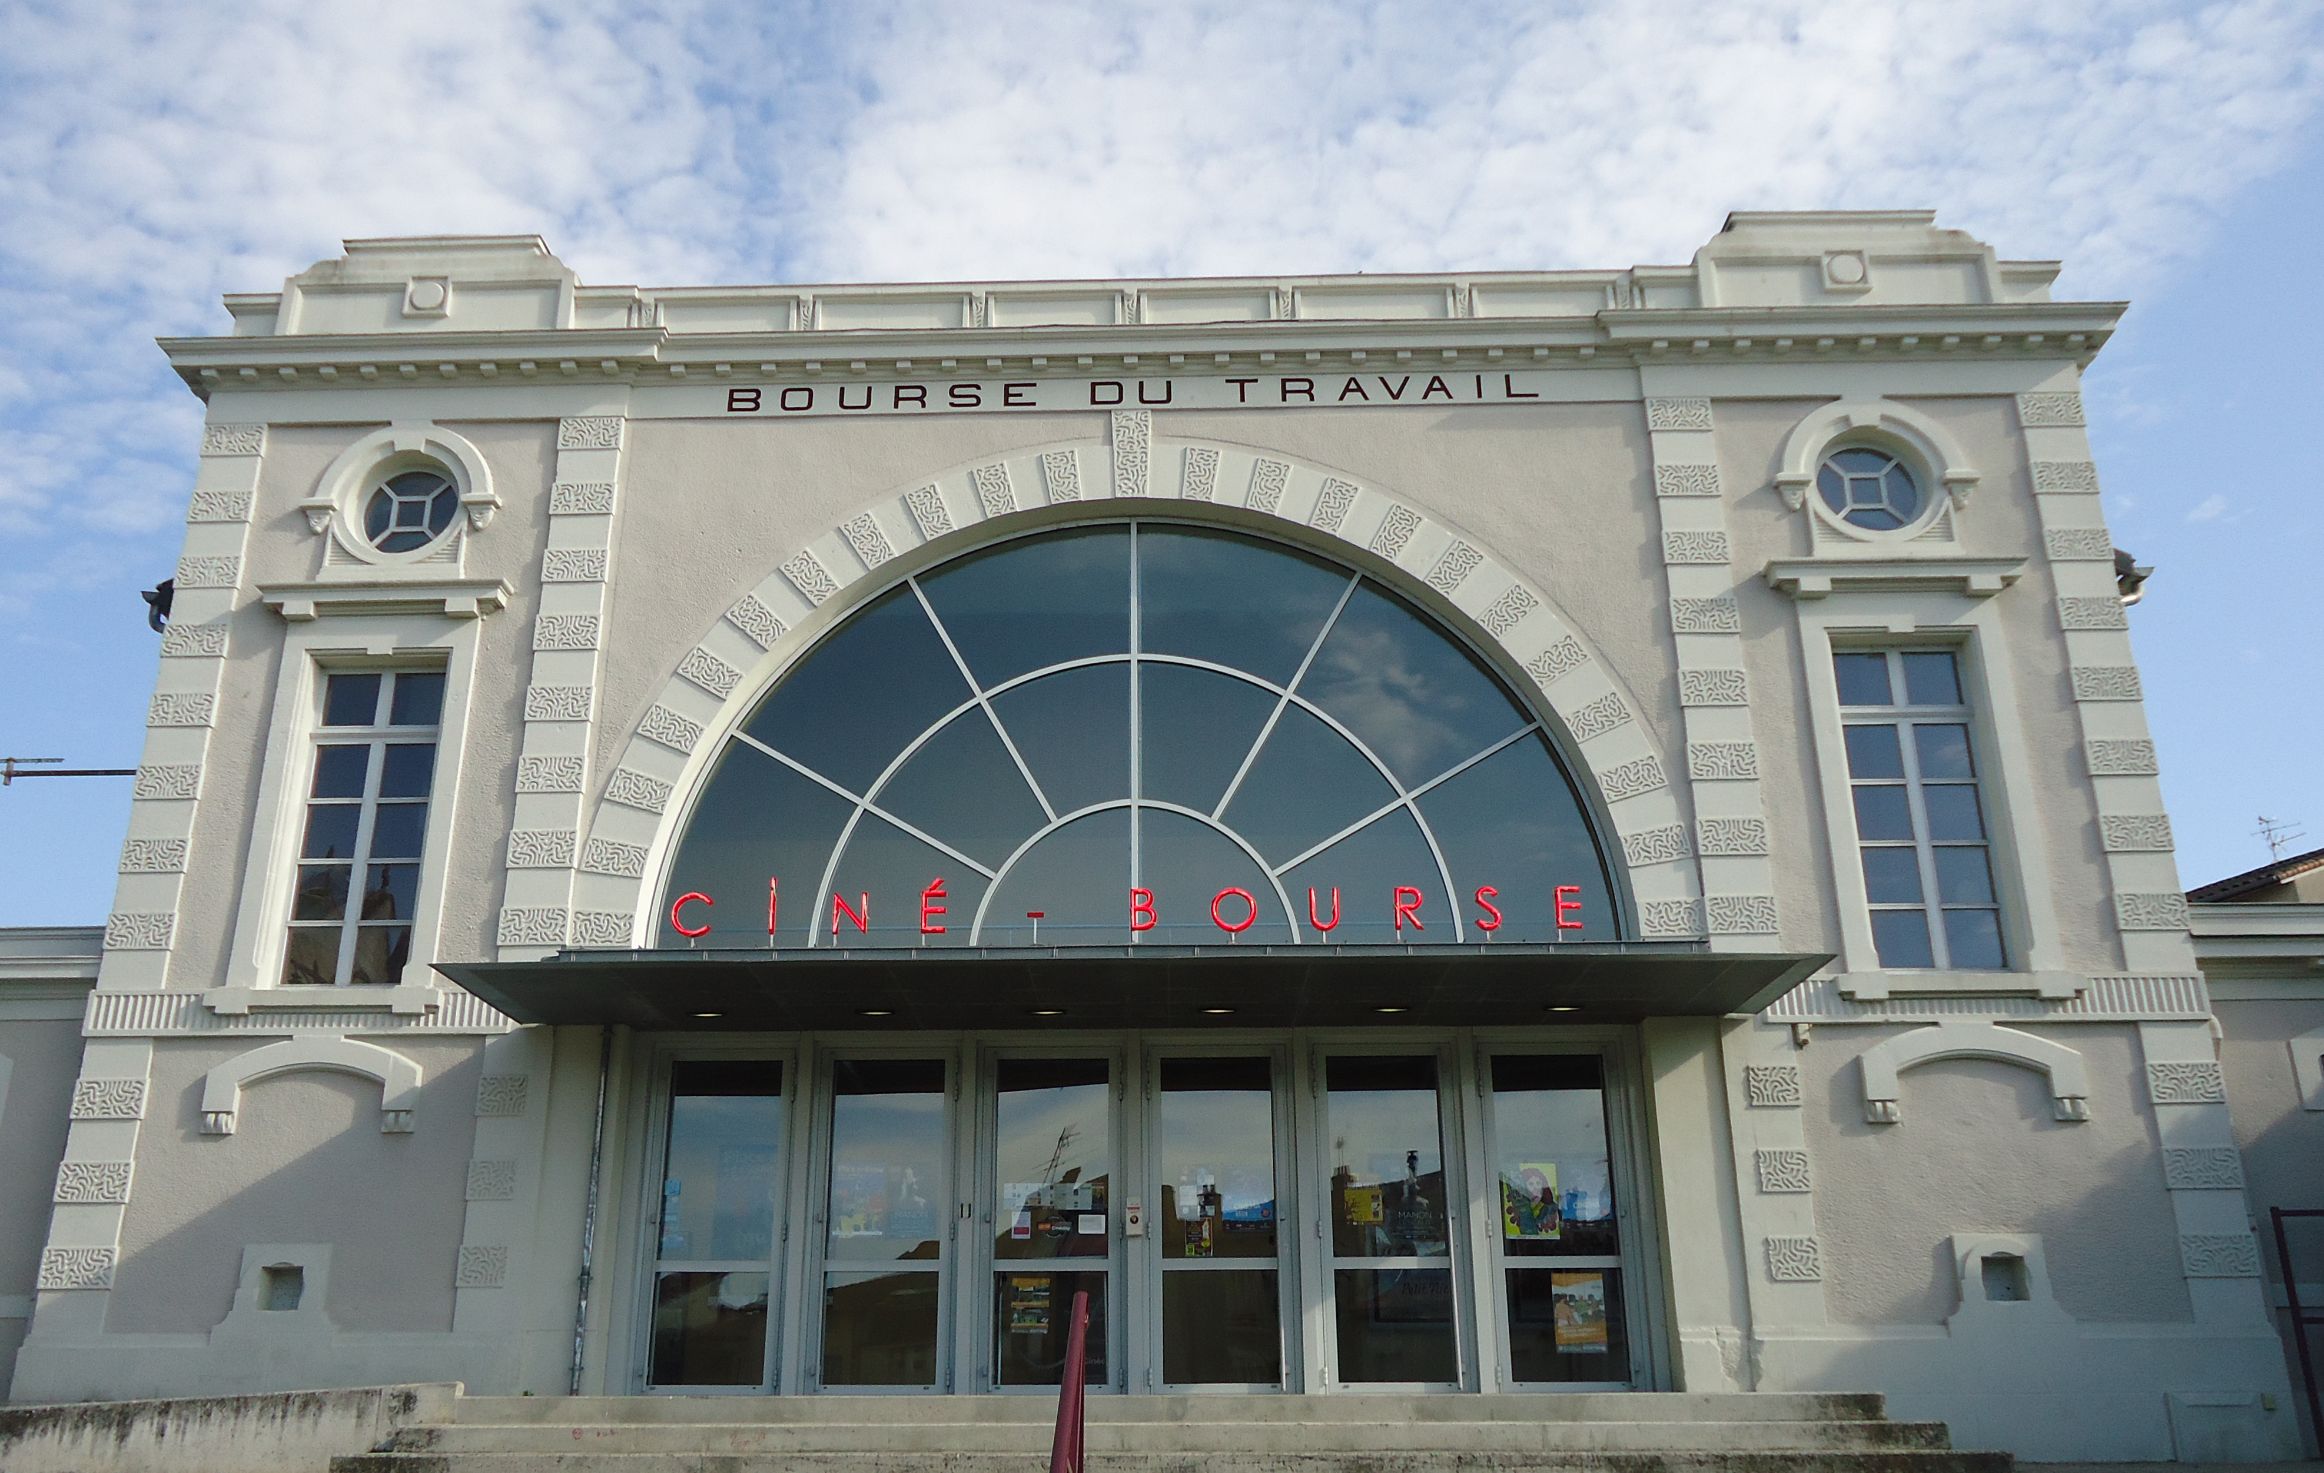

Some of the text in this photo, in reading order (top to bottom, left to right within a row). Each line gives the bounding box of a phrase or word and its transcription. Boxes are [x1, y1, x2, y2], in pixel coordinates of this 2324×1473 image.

[727, 373, 1540, 412] BOURSE DU TRAVAIL
[671, 877, 949, 937] CINÉ
[1129, 885, 1584, 933] BOURSE
